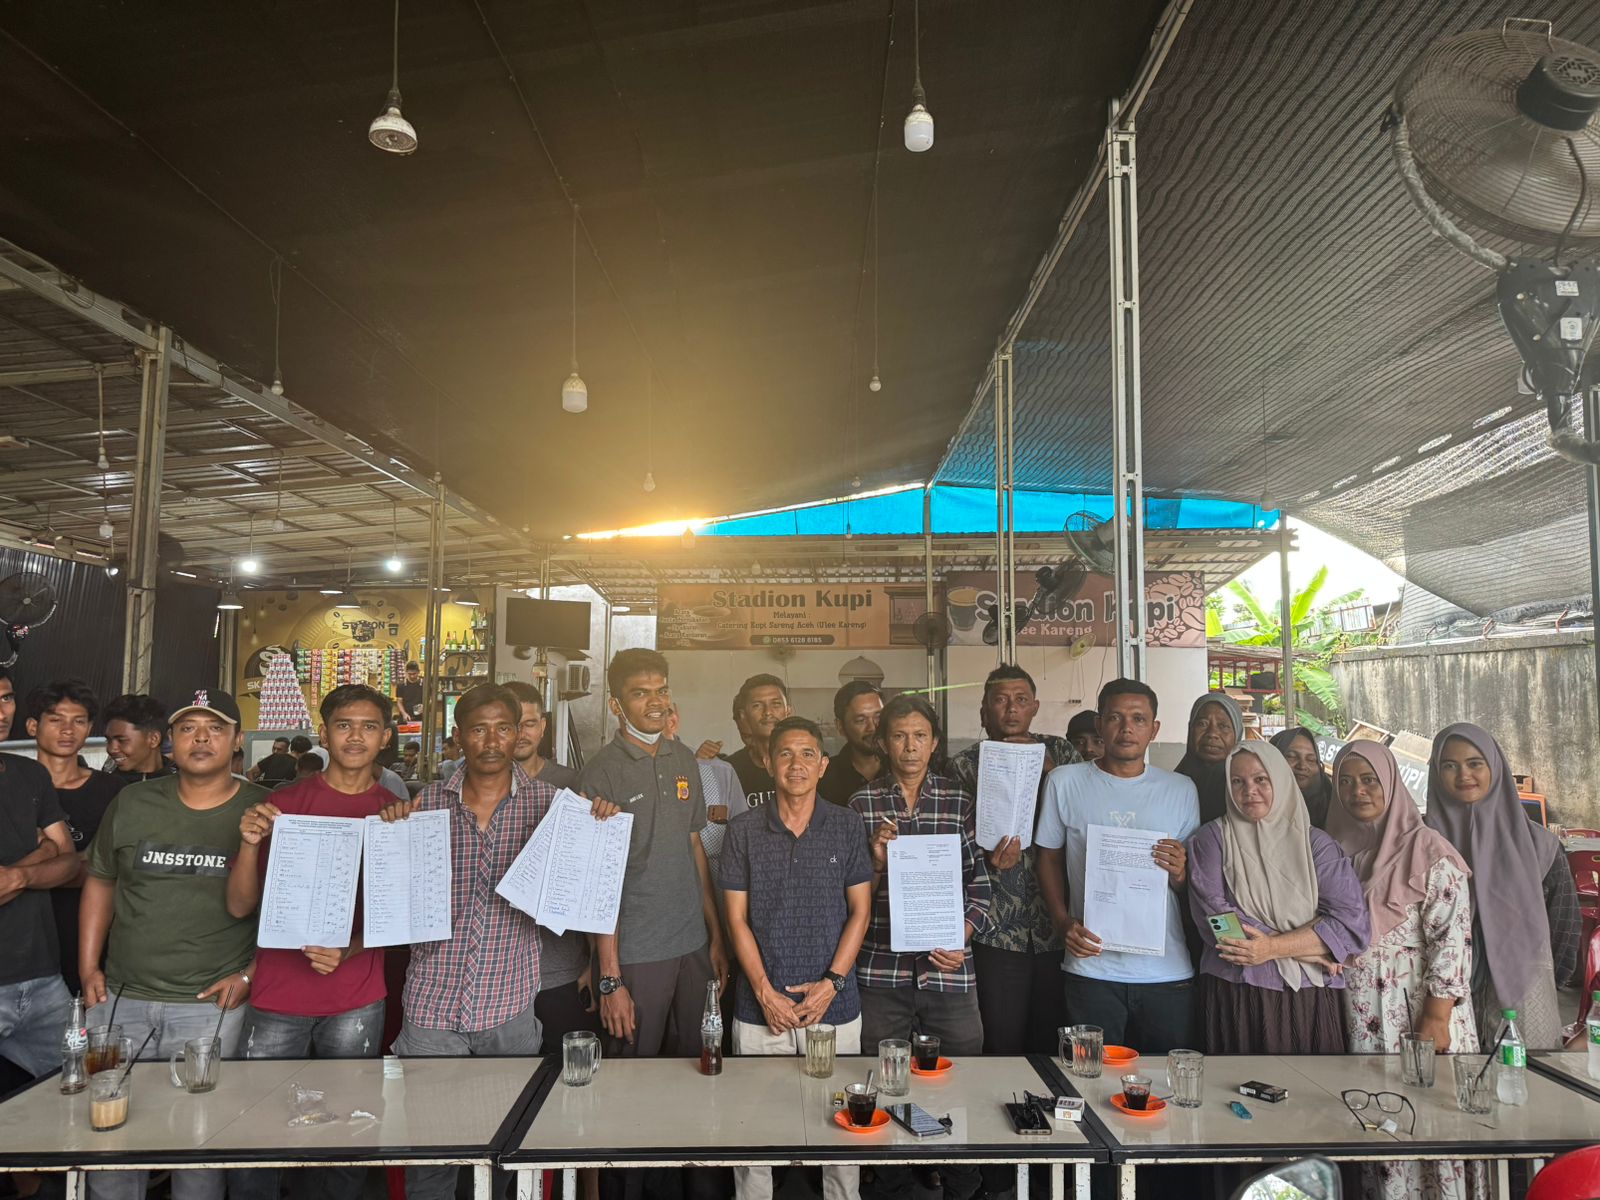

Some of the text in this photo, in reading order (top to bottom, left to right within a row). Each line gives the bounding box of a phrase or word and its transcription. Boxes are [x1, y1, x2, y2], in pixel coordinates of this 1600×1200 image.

[712, 590, 872, 611] Stadion Kupi
[975, 591, 1175, 628] Sdion Kpi
[1040, 623, 1093, 636] Kareng
[142, 850, 227, 868] JNSSTONE
